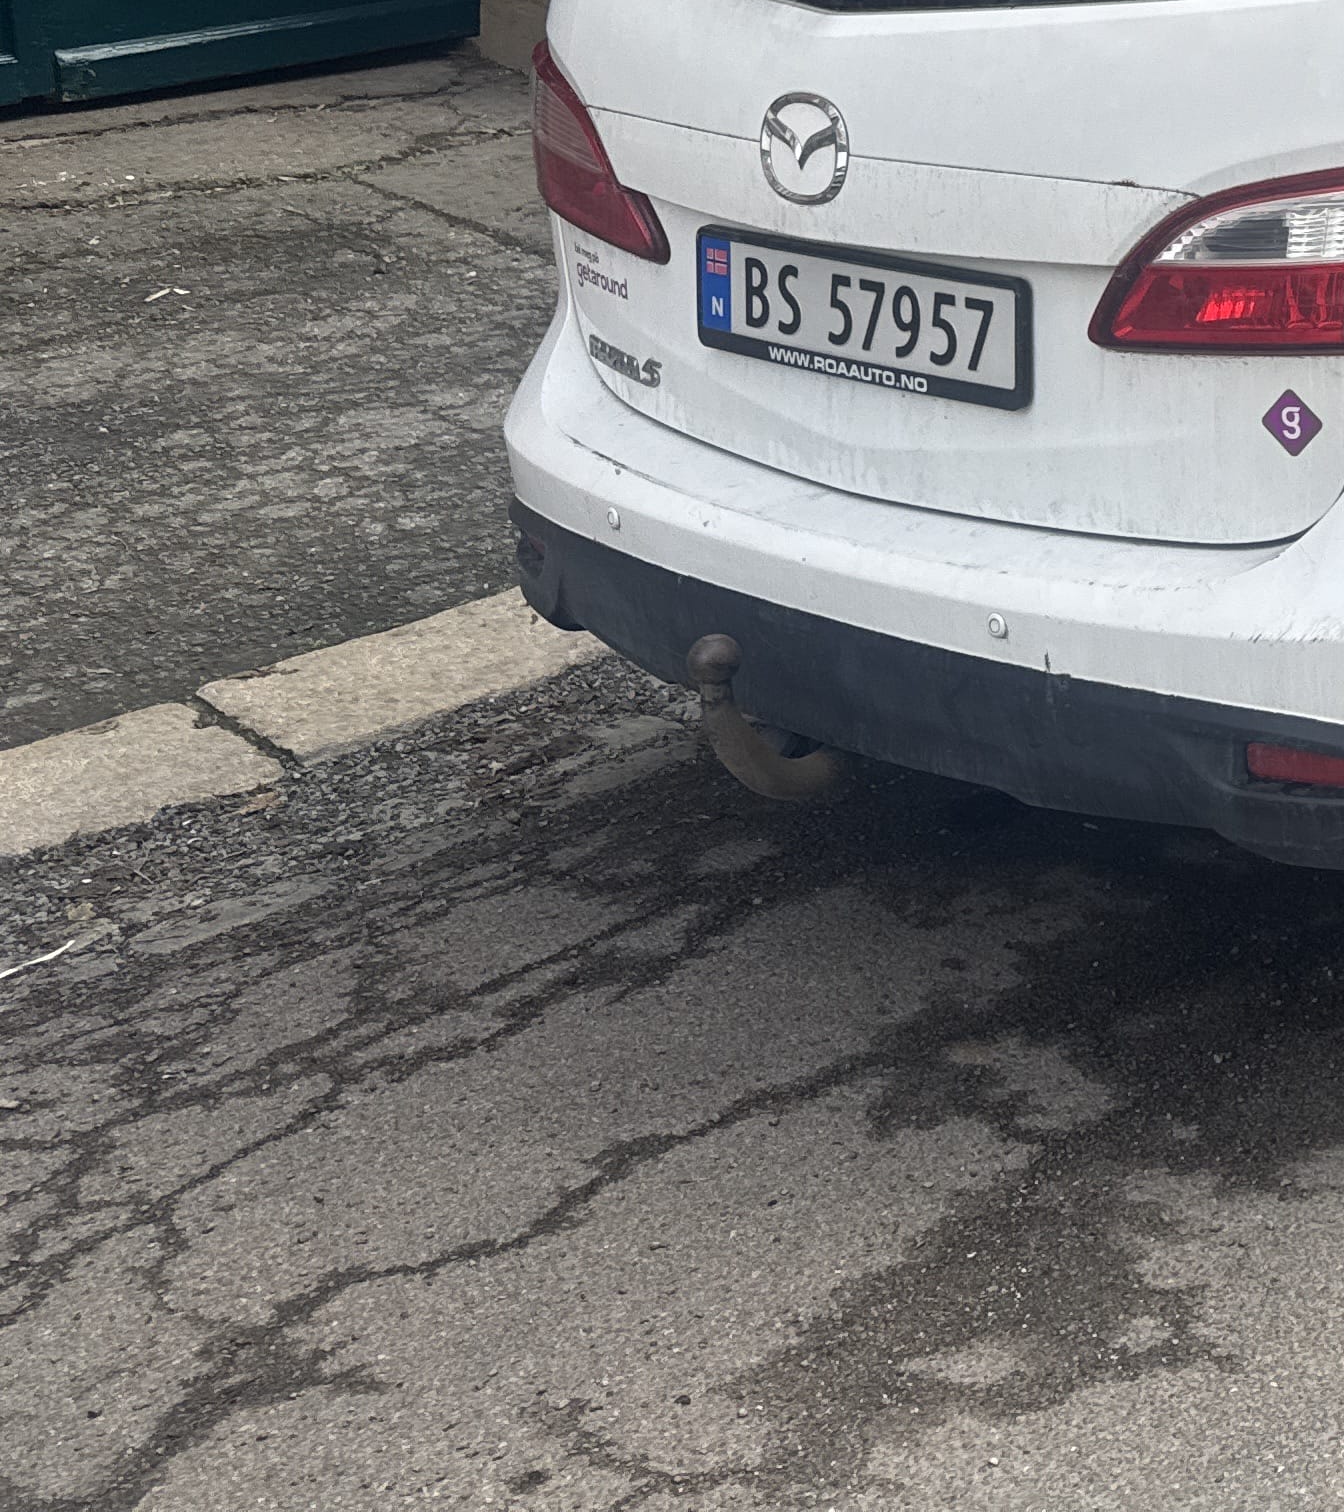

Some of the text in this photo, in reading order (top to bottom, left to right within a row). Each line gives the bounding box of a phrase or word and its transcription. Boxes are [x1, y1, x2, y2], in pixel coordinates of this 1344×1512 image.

[576, 262, 629, 300] getaround
[711, 296, 725, 318] N
[744, 257, 994, 372] BS 57957
[768, 345, 928, 393] WWW.ROAAUTO.NO
[1281, 406, 1301, 440] g
